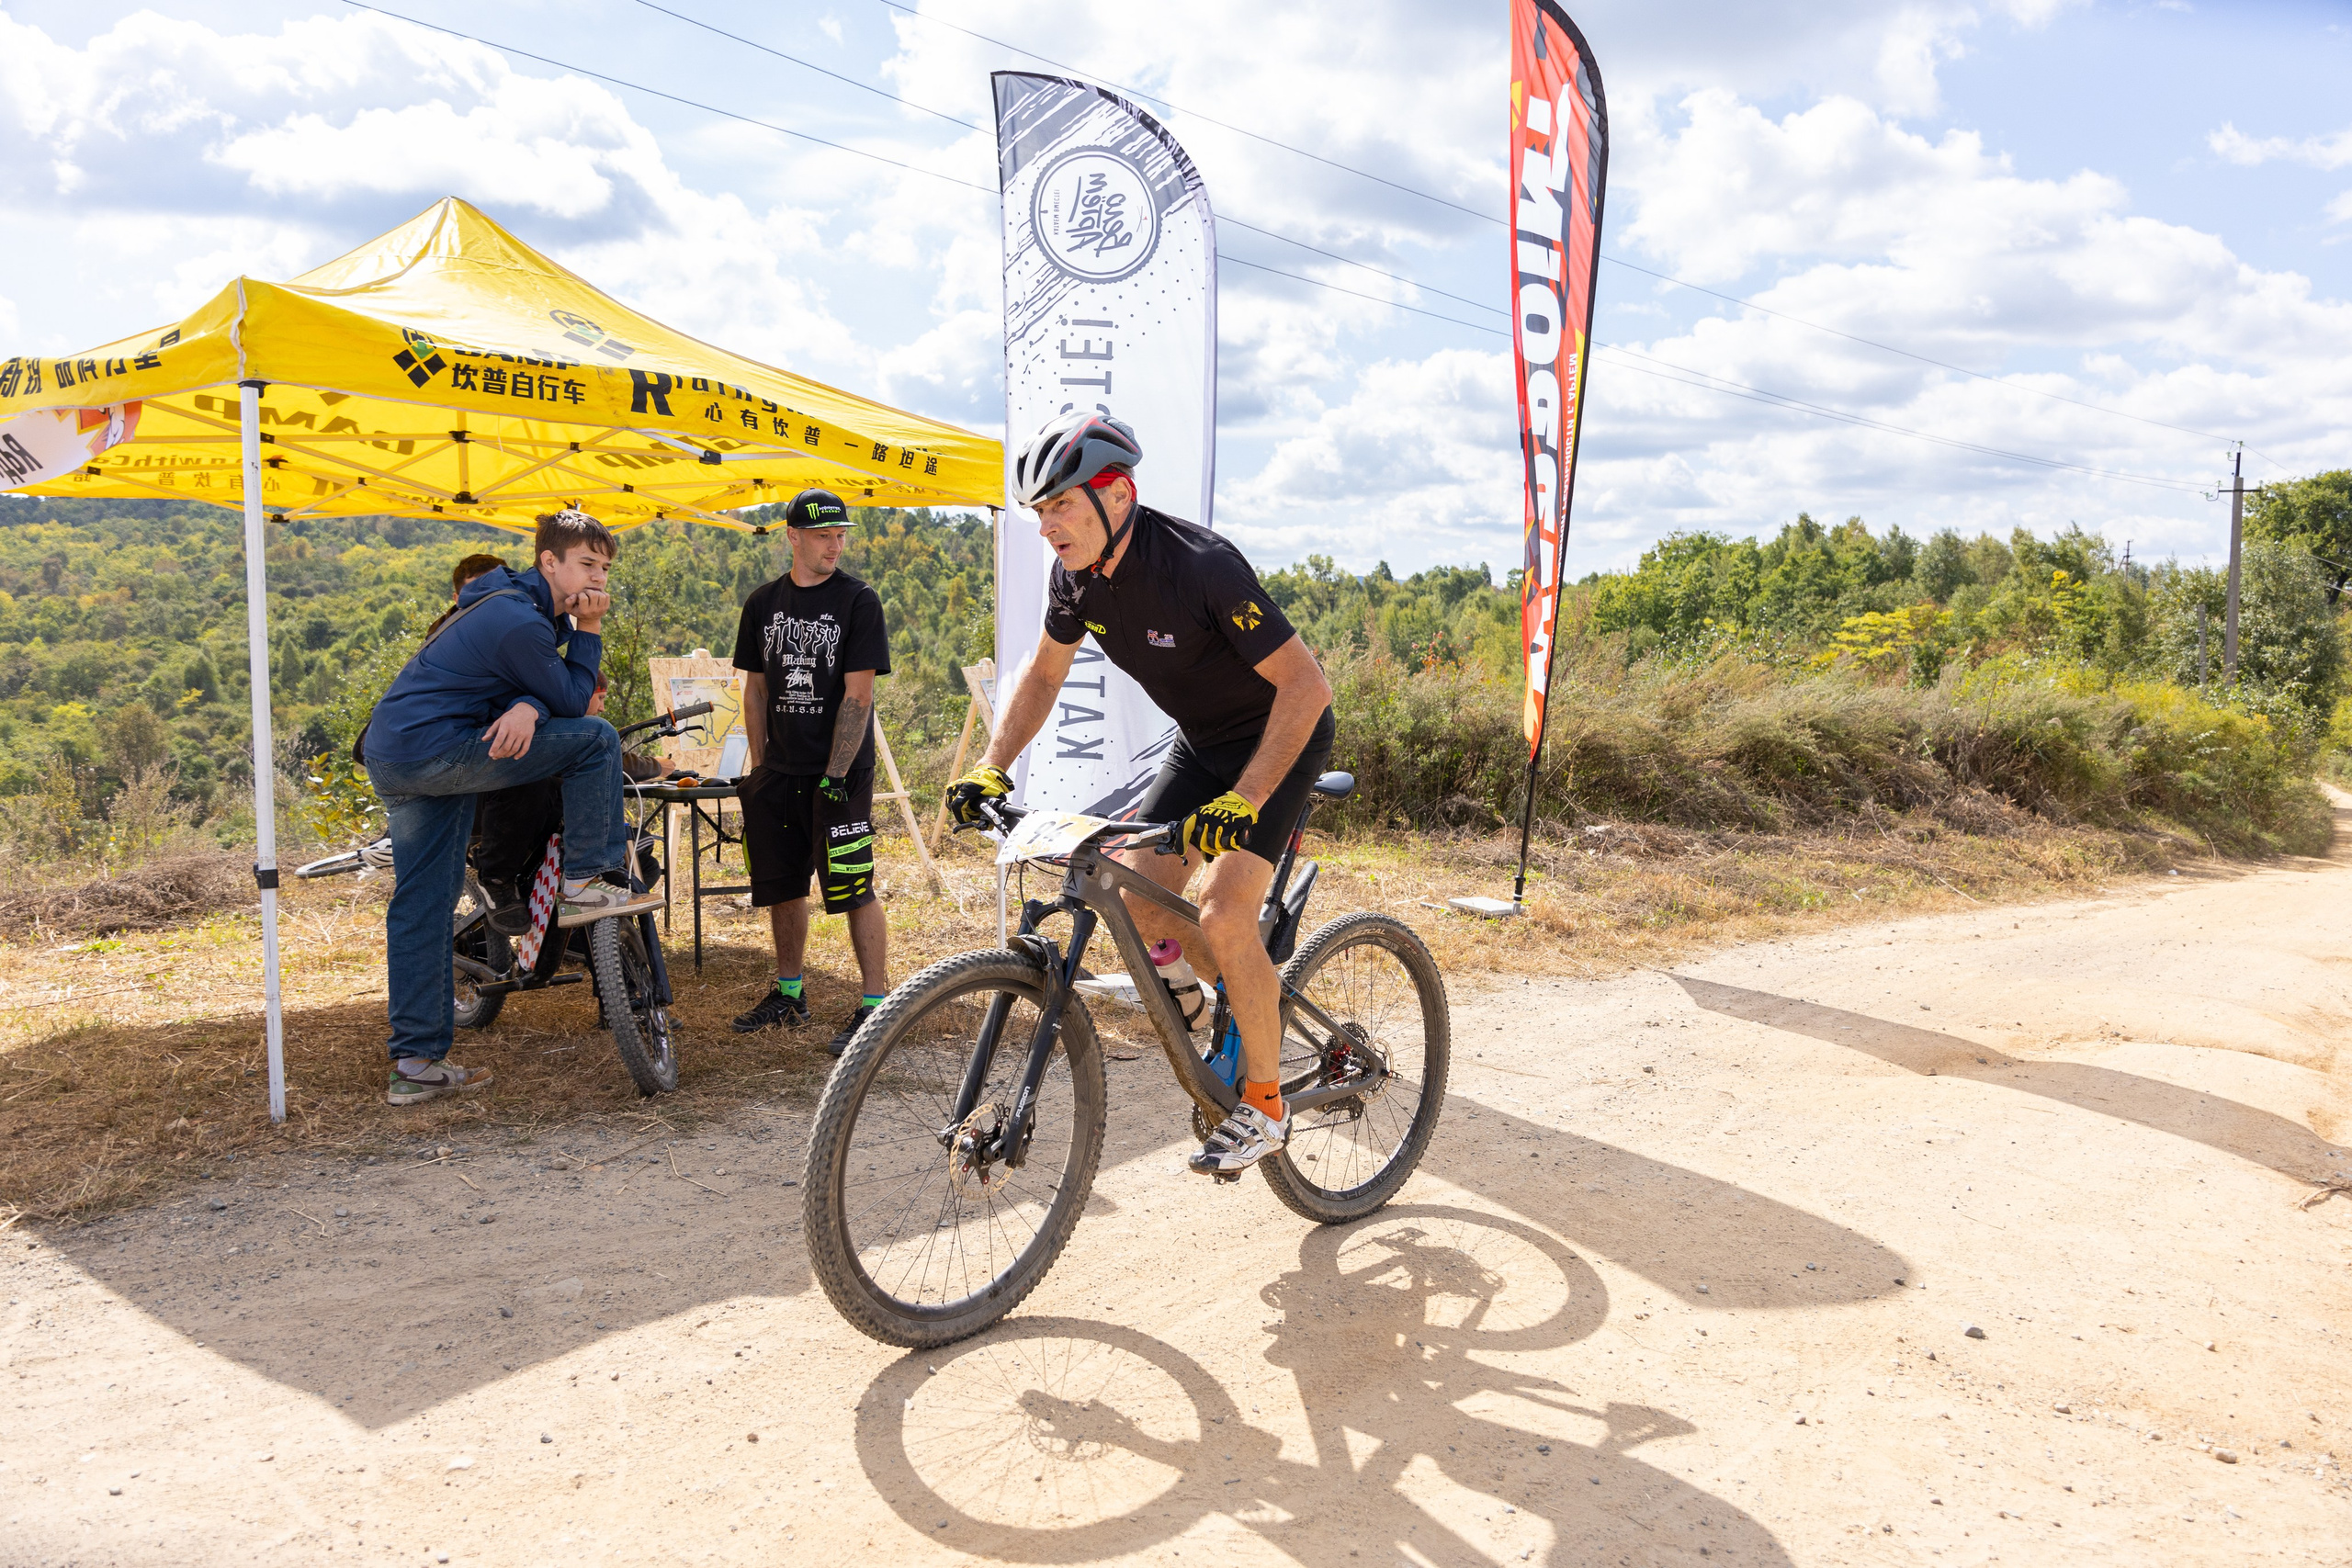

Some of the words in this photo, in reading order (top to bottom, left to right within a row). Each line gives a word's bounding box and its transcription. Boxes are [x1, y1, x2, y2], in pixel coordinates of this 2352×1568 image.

[451, 363, 586, 405] 坎普自行车
[781, 653, 818, 669] Making
